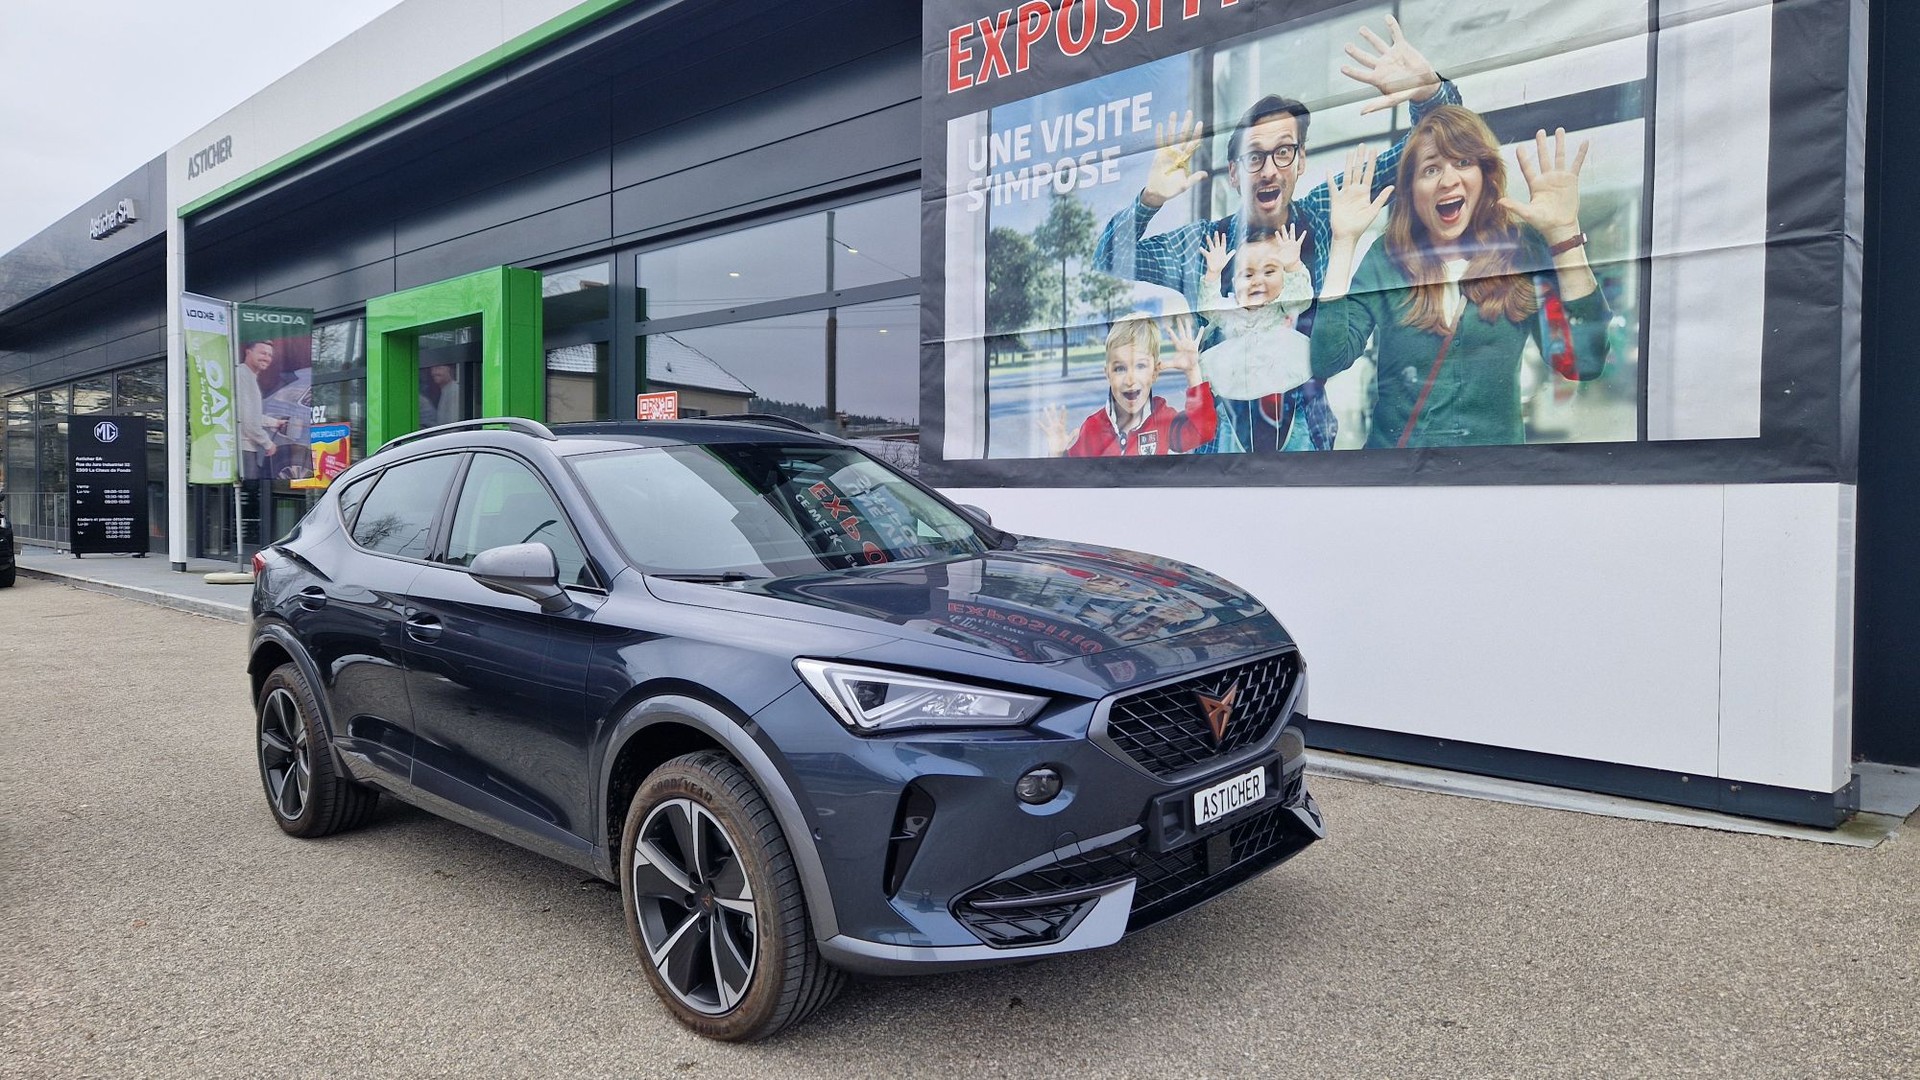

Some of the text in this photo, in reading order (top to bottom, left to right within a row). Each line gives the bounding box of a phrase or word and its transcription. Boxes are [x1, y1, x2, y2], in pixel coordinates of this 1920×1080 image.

[967, 91, 1153, 172] UNE VISITE
[188, 134, 233, 181] ASTICHER
[967, 146, 1122, 213] S'IMPOSE
[89, 198, 135, 240] Asticher SA
[96, 424, 117, 441] MG
[1203, 774, 1260, 821] ASTICHER
